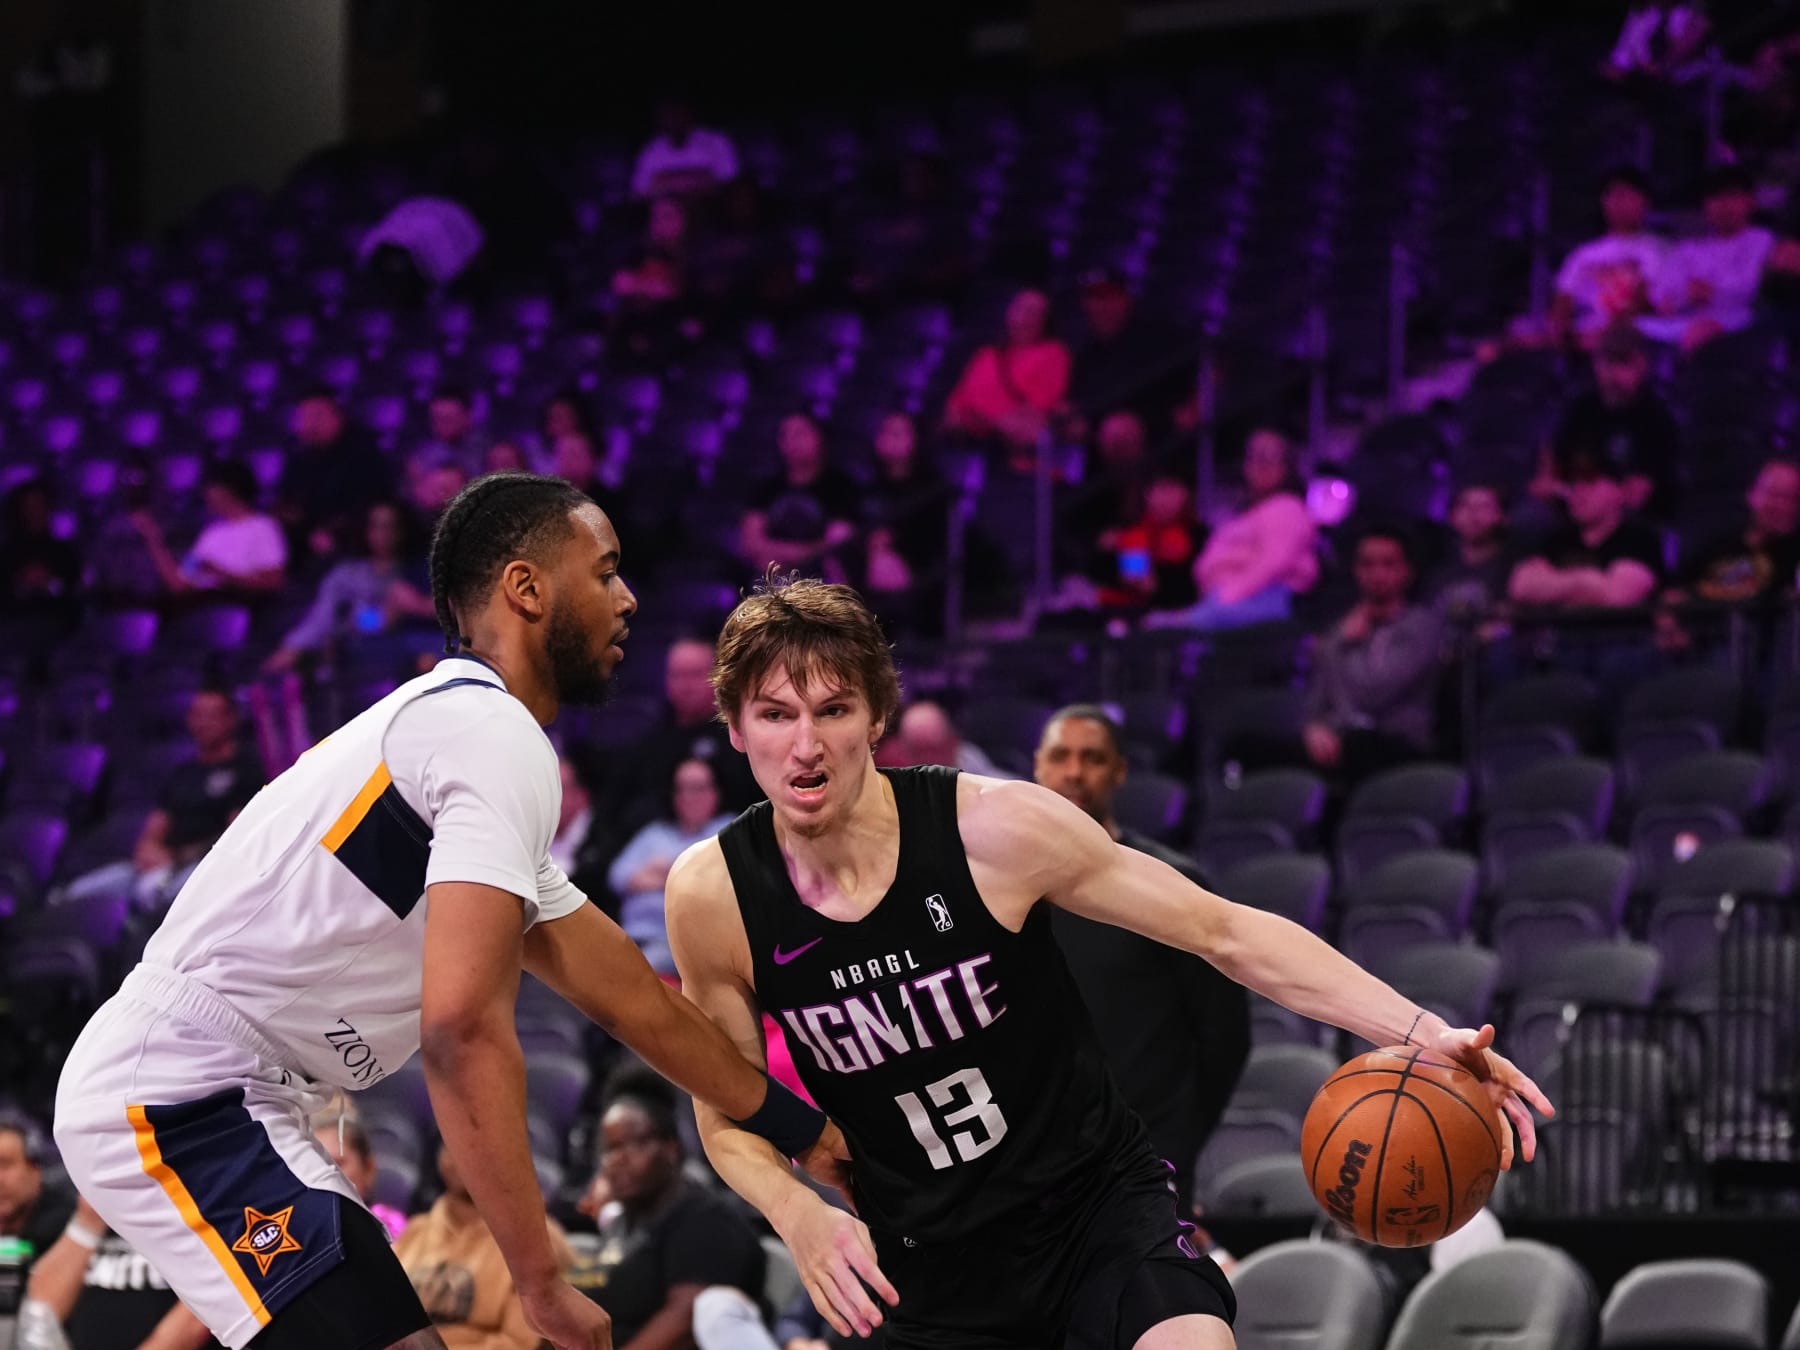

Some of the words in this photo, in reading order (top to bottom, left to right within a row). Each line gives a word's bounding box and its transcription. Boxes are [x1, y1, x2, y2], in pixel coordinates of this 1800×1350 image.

[830, 950, 920, 989] NBAGL
[780, 952, 1008, 1074] IGNITE
[894, 1067, 1008, 1170] 13
[253, 1225, 279, 1248] SLC
